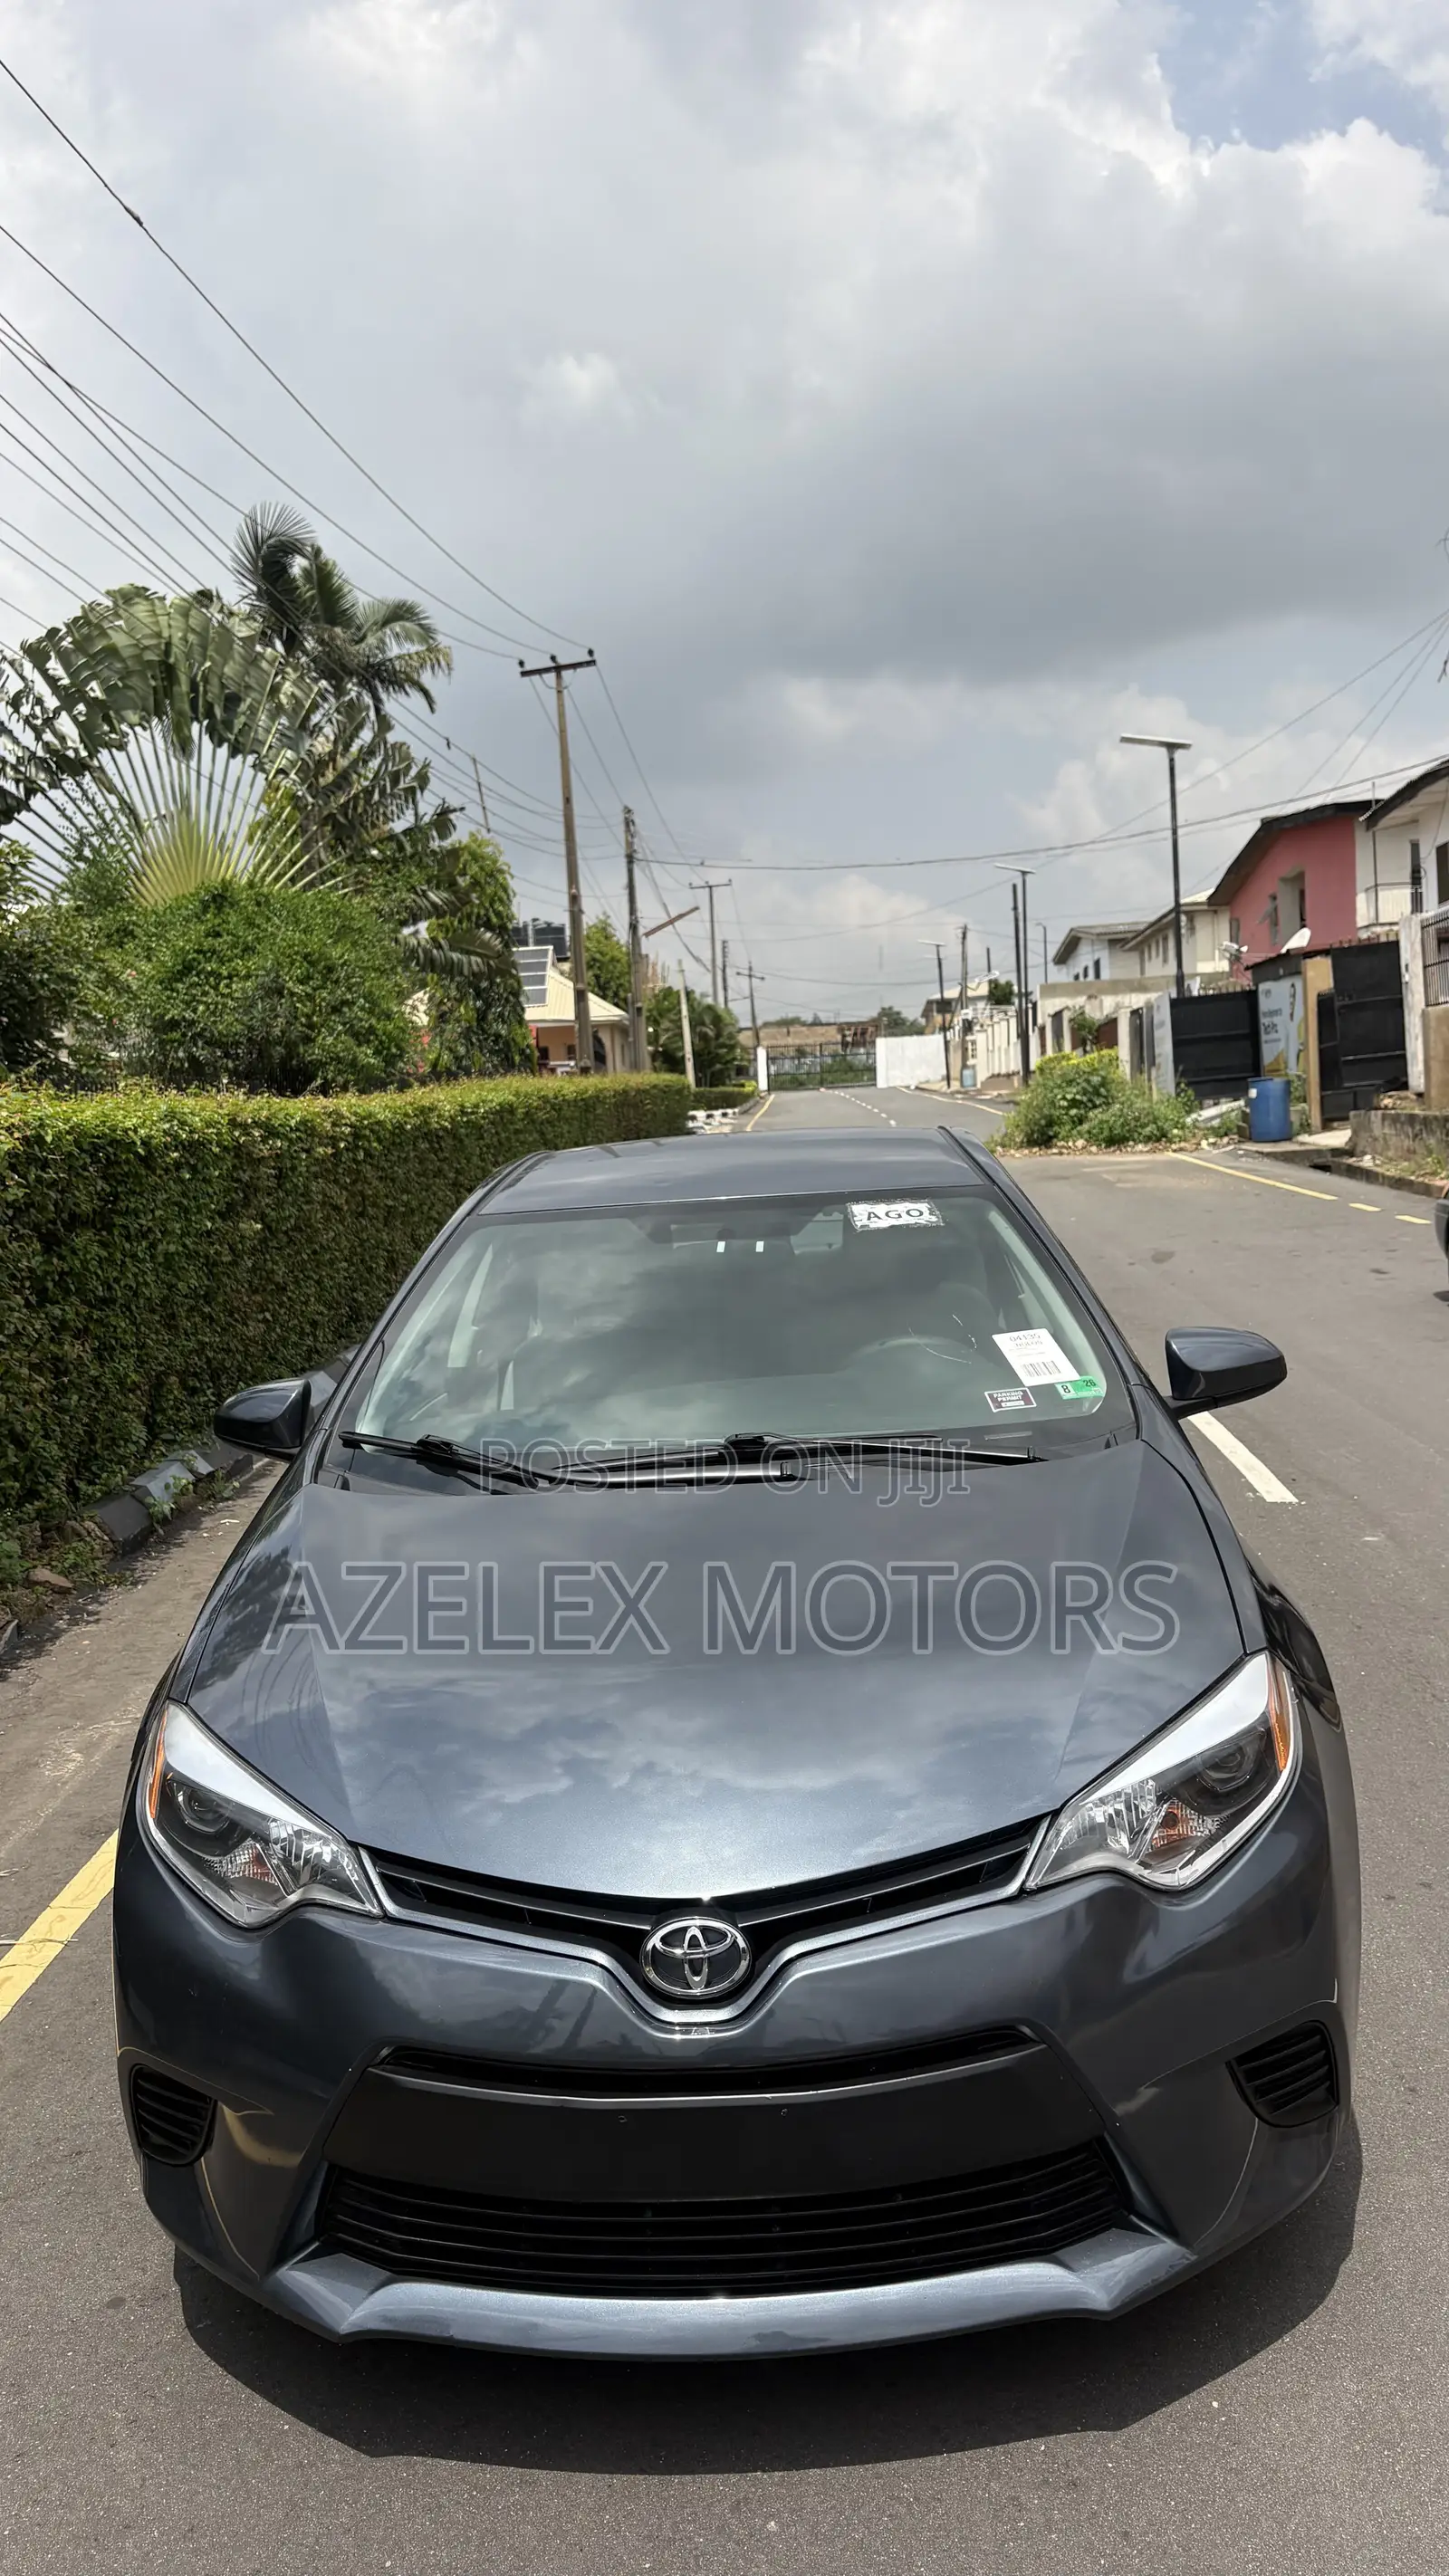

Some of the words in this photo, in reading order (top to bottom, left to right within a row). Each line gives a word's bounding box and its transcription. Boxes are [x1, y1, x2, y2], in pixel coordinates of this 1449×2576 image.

[1083, 1379, 1097, 1387] 26
[1061, 1384, 1070, 1393] 8
[993, 1390, 1023, 1398] PARKING
